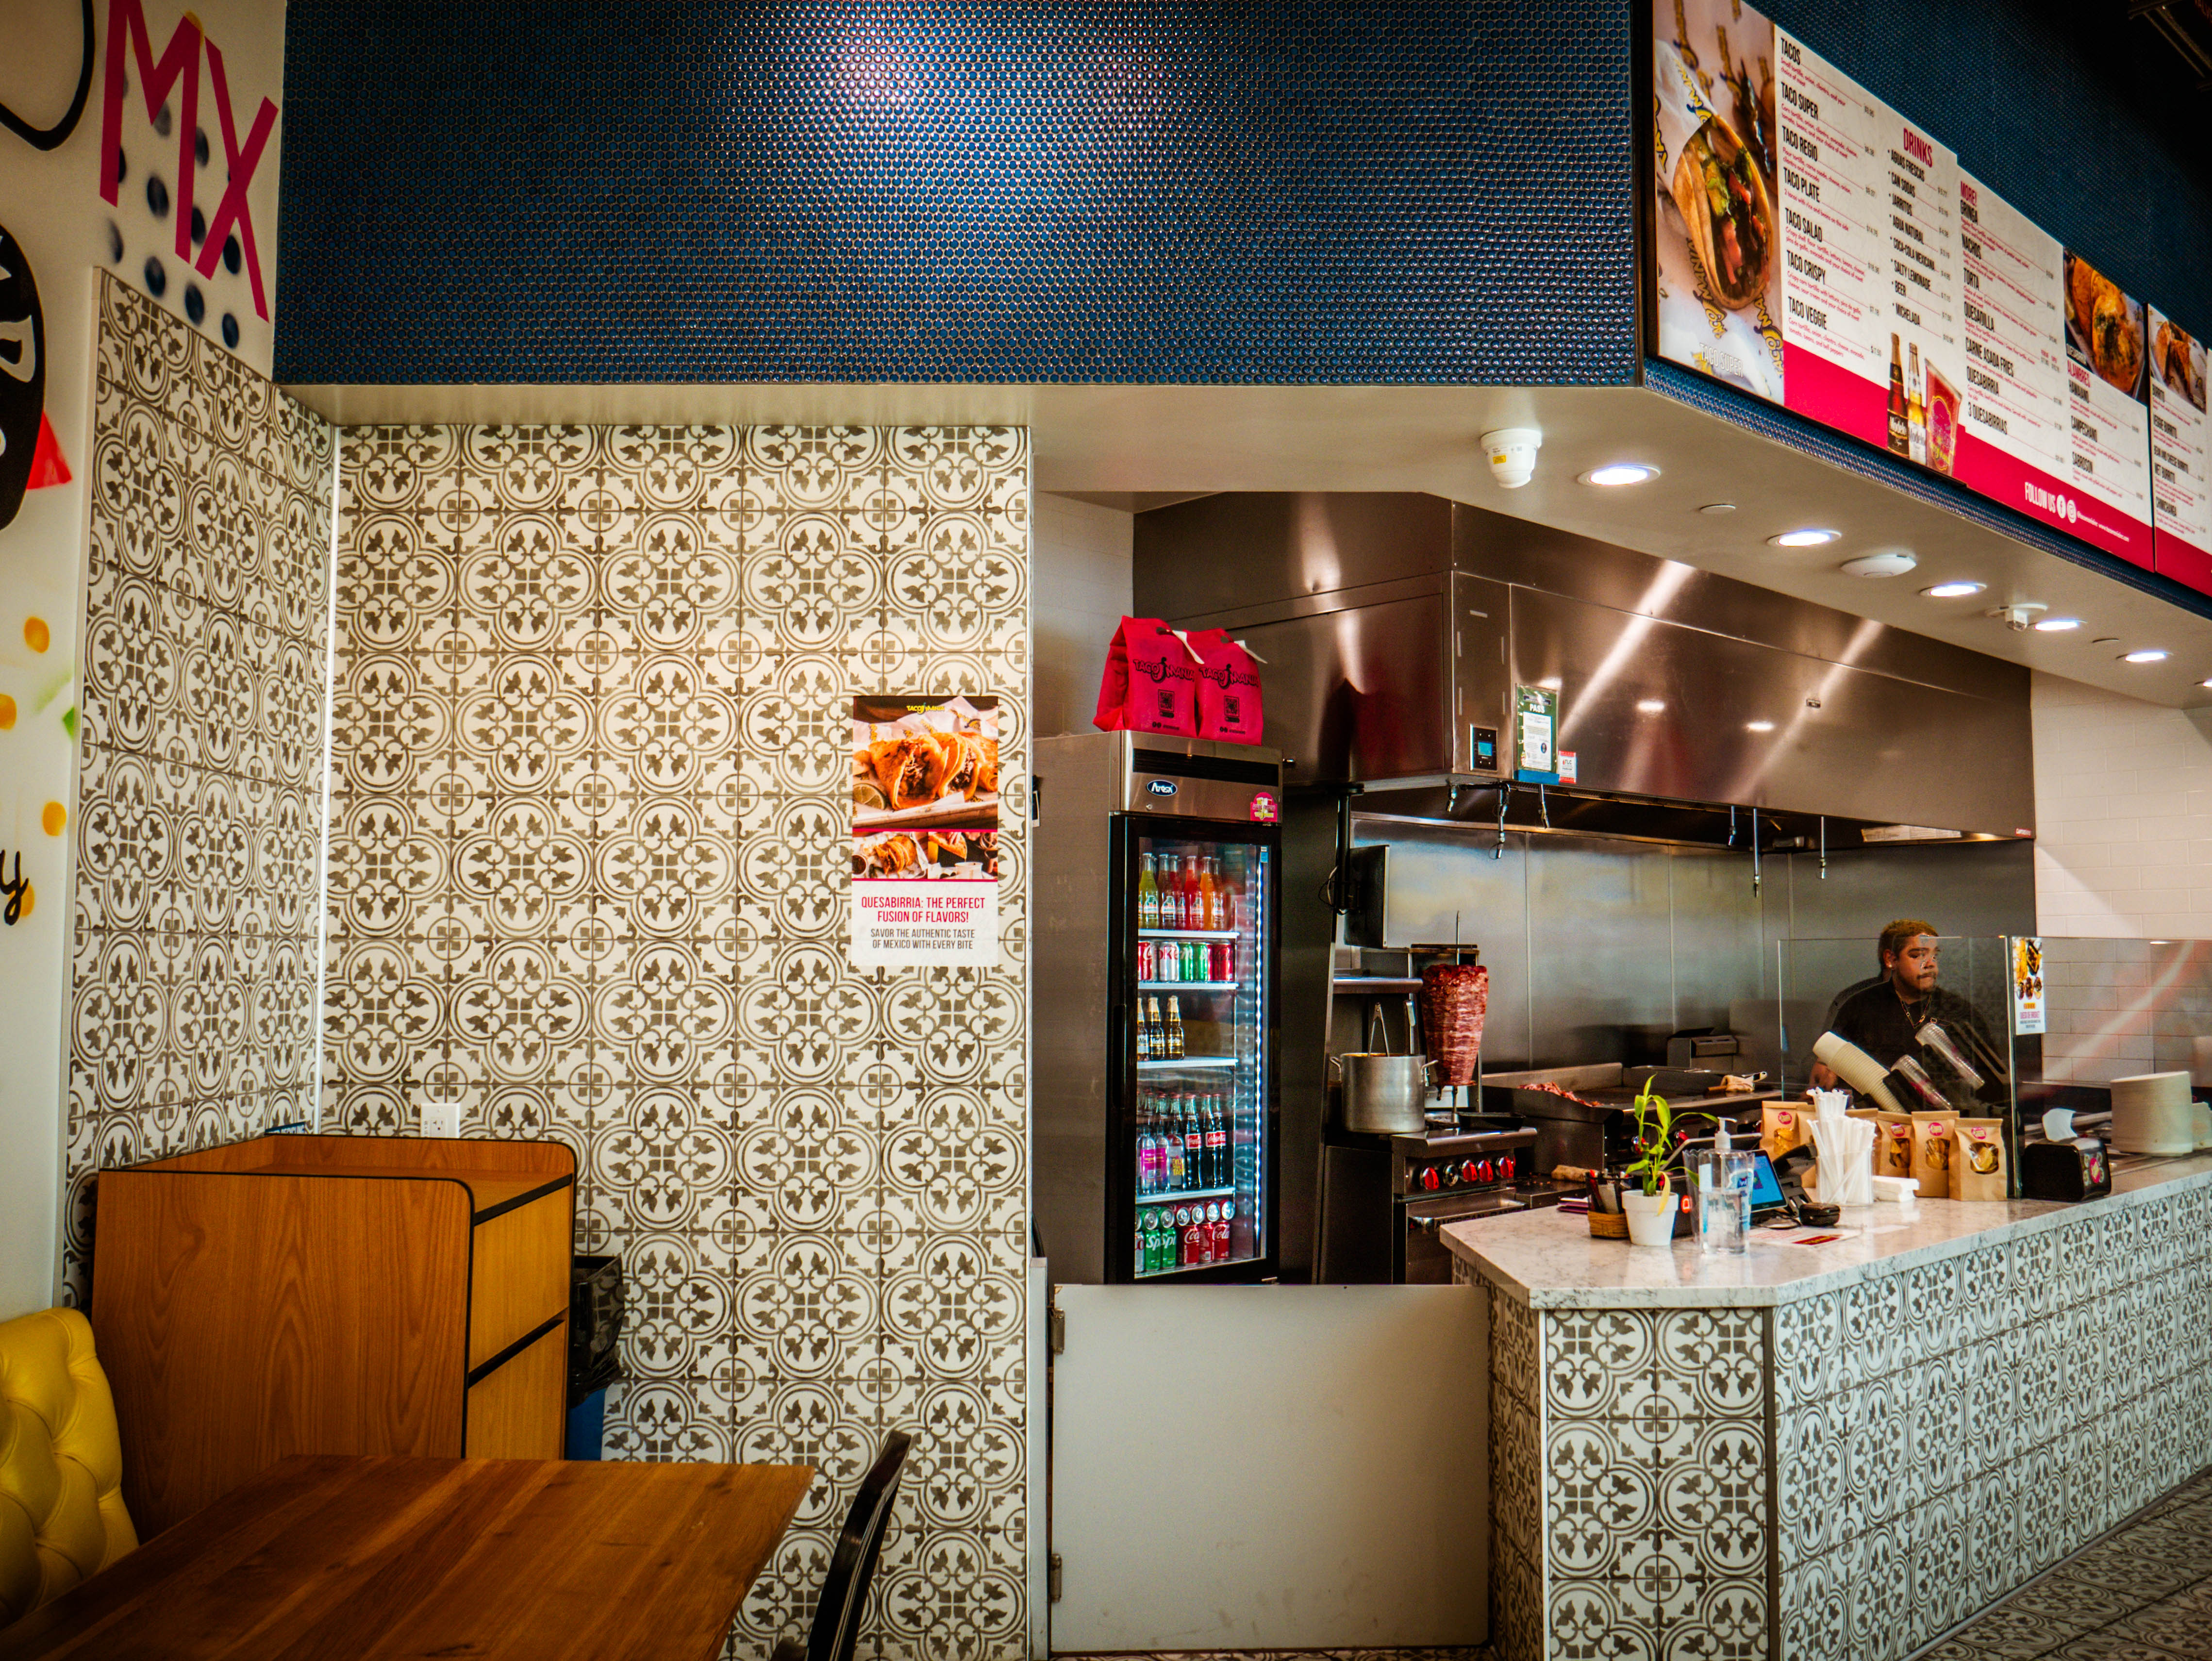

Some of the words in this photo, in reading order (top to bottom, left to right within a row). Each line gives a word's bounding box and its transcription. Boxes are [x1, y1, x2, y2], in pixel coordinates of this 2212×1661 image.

[1780, 37, 1800, 66] TACOS
[1781, 82, 1796, 106] TACO
[1798, 93, 1818, 120] SUPER
[1782, 126, 1798, 149] TACO
[1799, 137, 1817, 162] REGIO
[1903, 128, 1932, 167] DRINKS
[1891, 149, 1905, 168] AGUAS
[1906, 159, 1924, 182] FRESCAS
[1783, 167, 1799, 190] TACO
[1801, 178, 1819, 202] PLATE
[1892, 172, 1900, 187] CAN
[1901, 178, 1915, 197] SODAS
[1961, 182, 1977, 206] MORE!
[1892, 194, 1912, 216] JARRITOS
[1785, 208, 1801, 230] TACO
[1802, 218, 1822, 242] SALAD
[1893, 216, 1904, 231] AGUA
[1905, 223, 1924, 243] NATURAL
[1894, 238, 1914, 258] COCA-COLA
[1915, 251, 1934, 270] MEXICANA
[1962, 234, 1980, 259] NACHOS
[1787, 250, 1802, 272] TACO
[1804, 260, 1825, 284] CRISPY
[1894, 261, 1906, 277] SALTY
[1908, 269, 1930, 291] LEMONADE
[1963, 268, 1979, 290] TORTA
[1895, 281, 1906, 296] BEER
[1788, 297, 1803, 318] TACO
[1806, 306, 1827, 329] VEGGIE
[1896, 303, 1920, 326] MICHELADA
[1964, 301, 1994, 332] QUESADILLA
[1700, 343, 1719, 368] TACO
[1720, 352, 1744, 377] SUPER
[1965, 337, 1982, 359] CARNE
[1984, 348, 1998, 368] ASADA
[2000, 357, 2013, 377] FRIES
[1967, 365, 1998, 396] QUESABIRRIA
[1968, 402, 1971, 415] 3
[1973, 404, 2007, 434] QUESABIRRIAS
[2025, 482, 2047, 510] FOLLOW
[2048, 493, 2056, 514] US
[1530, 703, 1545, 714] PASS
[862, 897, 923, 908] QUESABIRRIA:
[926, 897, 943, 908] THE
[946, 897, 985, 909] PERFECT
[878, 911, 909, 922] FUSION
[912, 911, 923, 922] OF
[926, 912, 969, 922] FLAVORS!
[871, 929, 894, 938] SAVOR
[897, 929, 909, 938] THE
[912, 929, 951, 938] AUTHENTIC
[953, 929, 975, 938] TASTE
[872, 940, 881, 948] OF
[883, 940, 910, 948] MEXICO
[913, 940, 931, 948] WITH
[932, 940, 955, 949] EVERY
[957, 940, 973, 949] BITE
